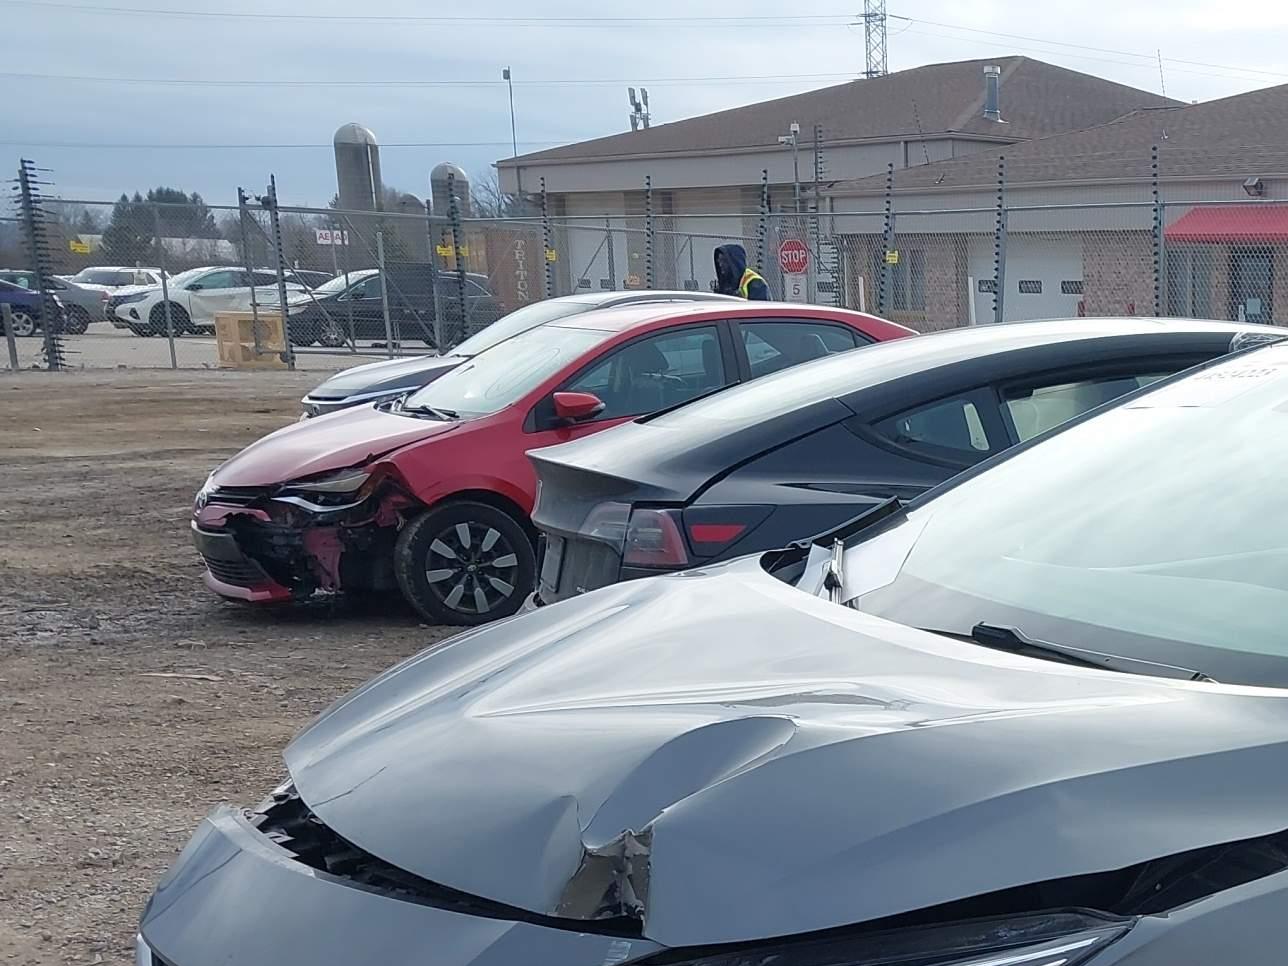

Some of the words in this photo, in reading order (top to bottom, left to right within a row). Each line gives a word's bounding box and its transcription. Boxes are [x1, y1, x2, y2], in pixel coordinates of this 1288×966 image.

[781, 249, 806, 264] STOP
[514, 239, 529, 301] TRITON
[792, 283, 801, 296] 5
